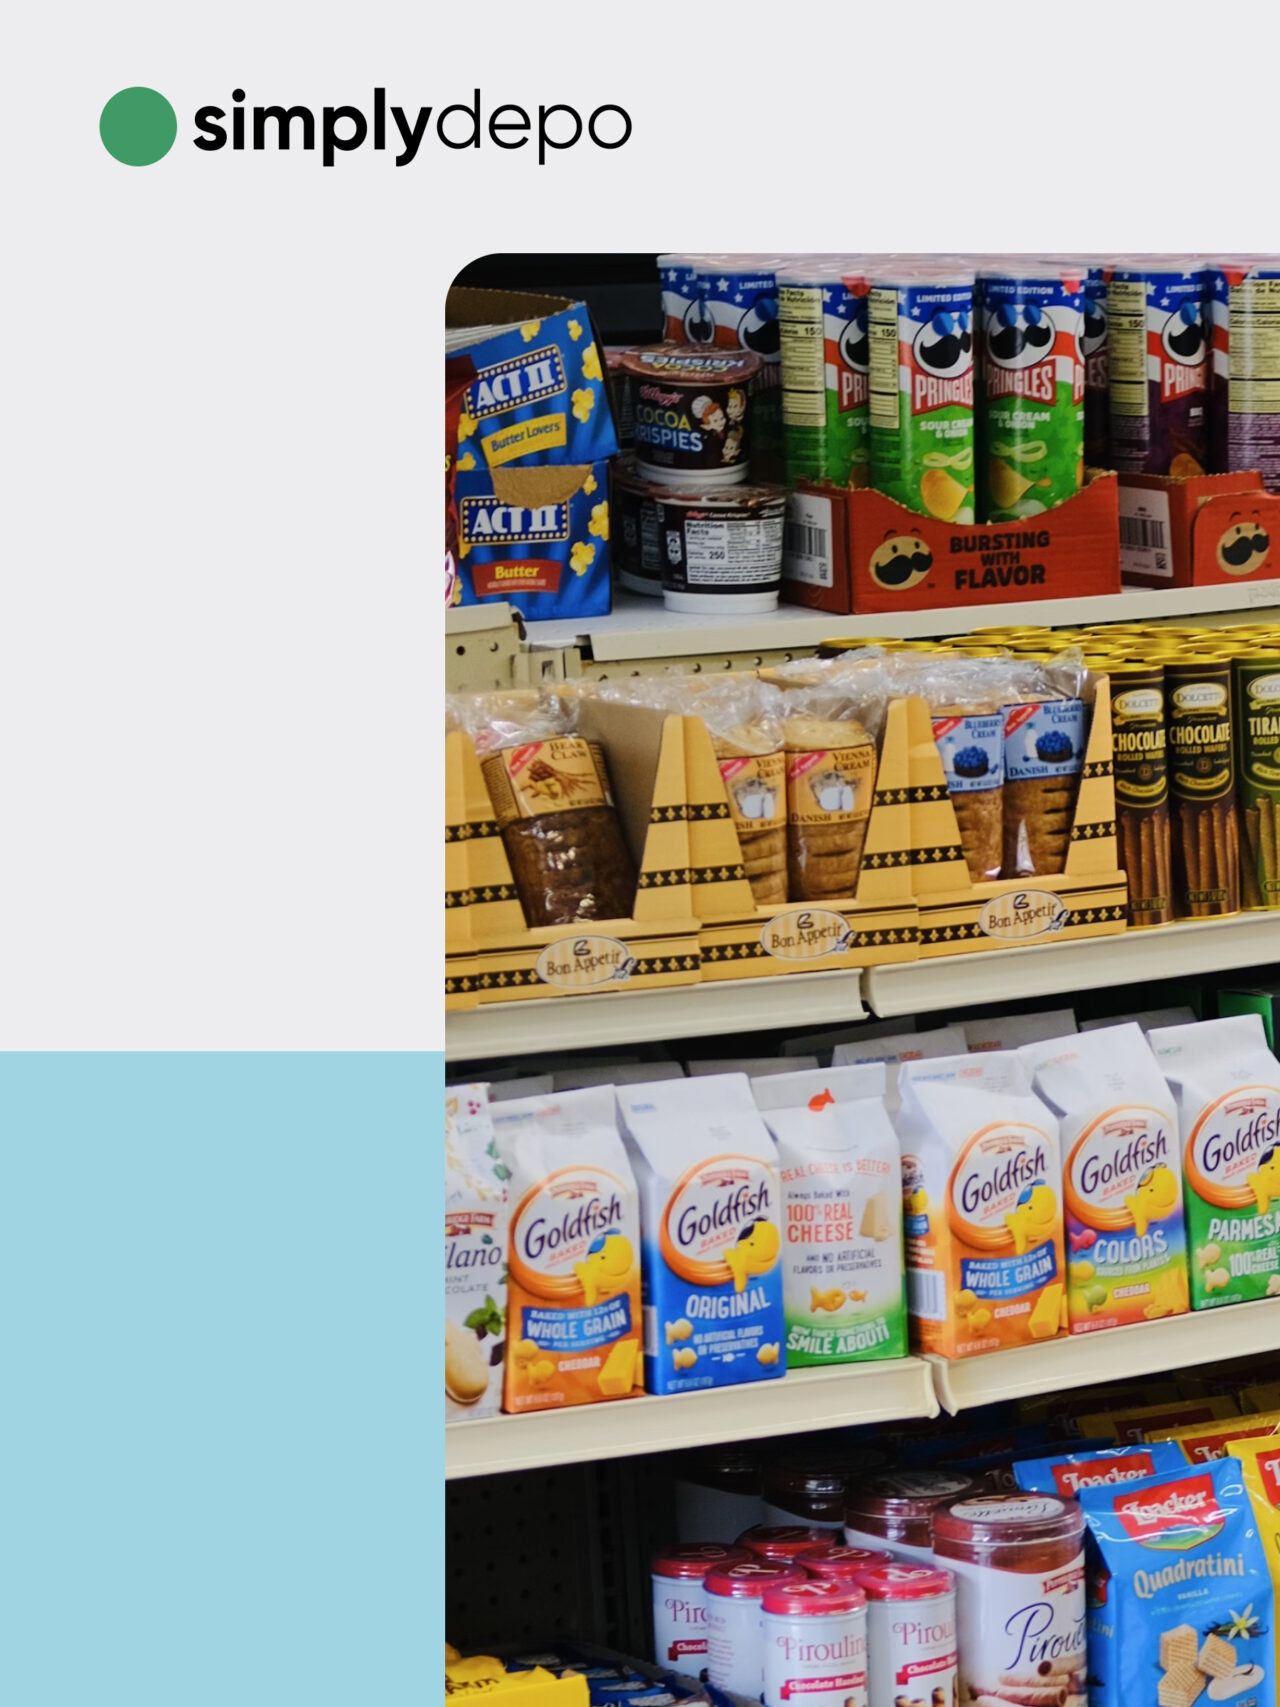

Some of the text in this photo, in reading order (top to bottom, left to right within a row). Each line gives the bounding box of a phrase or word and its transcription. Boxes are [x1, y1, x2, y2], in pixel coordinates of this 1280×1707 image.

[916, 294, 951, 303] LIMITED
[1016, 286, 1053, 295] EDITION
[476, 368, 524, 410] ACT
[986, 364, 1052, 400] PRINGLES
[490, 420, 561, 453] Butter Lovers
[919, 420, 950, 431] SOUR
[472, 508, 526, 536] ACT
[949, 531, 1050, 554] BURSTING
[708, 550, 726, 561] 250
[981, 551, 1020, 567] WITH
[494, 565, 540, 580] Butter
[954, 564, 1046, 590] FLAVOR
[1051, 713, 1079, 726] CREAM
[971, 728, 996, 740] CREAM
[1169, 722, 1231, 745] CHOCOLATE
[549, 741, 583, 752] BEAR
[551, 750, 588, 761] CLAW
[833, 751, 871, 762] VIENNA
[833, 761, 871, 772] CREAM
[1009, 765, 1049, 778] DANISH
[791, 812, 832, 824] DANISH
[989, 912, 1012, 929] Bon
[771, 932, 796, 948] Bon
[546, 960, 572, 976] Bon
[1080, 1128, 1168, 1194] Goldfish
[781, 1164, 806, 1182] REAL
[961, 1146, 1048, 1213] Goldfish
[678, 1180, 772, 1247] Goldfish
[824, 1202, 854, 1221] REAL
[524, 1192, 624, 1259] Goldfish
[787, 1222, 854, 1244] CHEESE
[446, 1242, 503, 1269] lano
[1093, 1229, 1169, 1265] COLORS
[966, 1256, 1054, 1290] WHOLE GRAIN
[685, 1286, 772, 1320] ORIGINAL
[527, 1308, 627, 1339] WHOLE GRAIN
[785, 1332, 833, 1355] SMILE
[1121, 1489, 1207, 1527] Loacker
[1133, 1552, 1246, 1601] Quadratini
[893, 1622, 955, 1646] Pirou
[1005, 1602, 1086, 1672] Pirou
[907, 1659, 947, 1675] Chocolate
[789, 1678, 834, 1692] Chocolate
